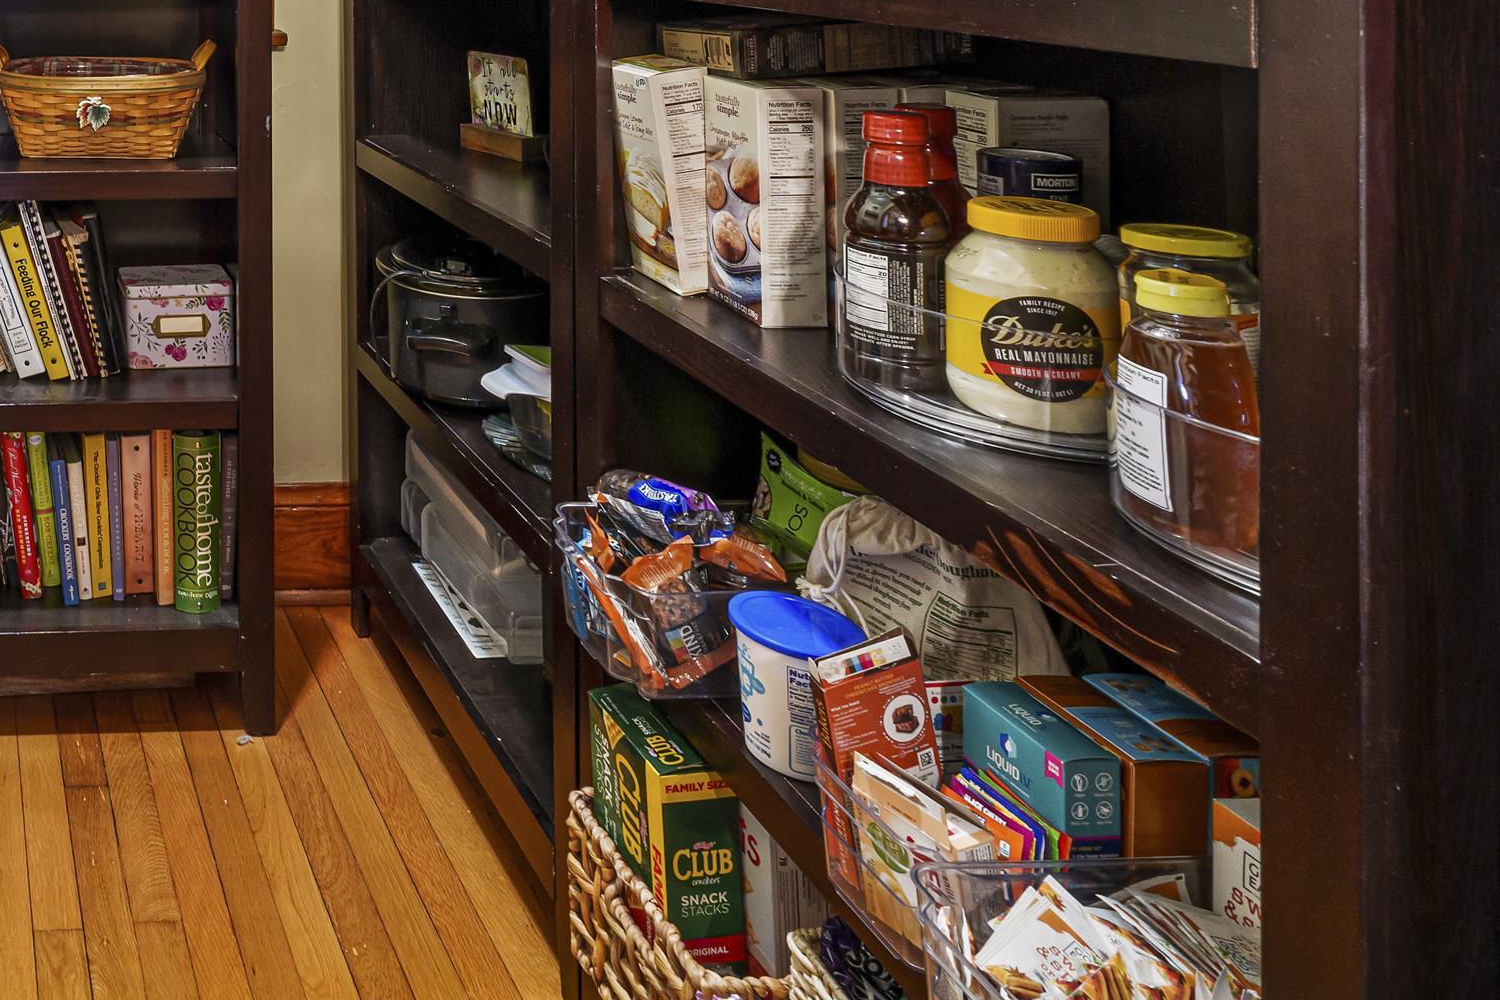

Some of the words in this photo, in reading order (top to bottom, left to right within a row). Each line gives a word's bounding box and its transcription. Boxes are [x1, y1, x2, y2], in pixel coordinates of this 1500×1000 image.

[481, 57, 493, 77] It
[500, 60, 516, 78] all
[485, 79, 515, 101] starts
[715, 94, 741, 108] tastefully
[483, 99, 517, 125] NOW
[692, 103, 703, 111] 170
[768, 101, 795, 109] Nutrition
[801, 124, 813, 132] 260
[1036, 178, 1076, 188] MORTON
[14, 257, 37, 298] Feeding
[27, 298, 44, 320] Our
[1019, 299, 1042, 309] FAMILY
[1043, 301, 1066, 312] RECIPE
[1027, 307, 1045, 315] SINCE
[35, 319, 54, 348] Flock
[983, 315, 1095, 349] Duke's
[995, 348, 1021, 361] REAL
[1023, 350, 1094, 365] MAYONNAISE
[1010, 367, 1042, 378] SMOOTH
[1051, 371, 1081, 379] CREAMY
[1137, 371, 1160, 385] Facts
[132, 472, 142, 501] Works
[59, 507, 69, 541] CROCKERY
[176, 452, 196, 584] COOKBOOK
[16, 524, 26, 564] DRUMMOND
[21, 515, 32, 556] DINNERTIME
[133, 513, 144, 562] HEART
[162, 522, 170, 574] COOKBOOK
[62, 543, 73, 580] COOKBOOK
[96, 536, 104, 569] Companion
[789, 679, 812, 688] Fact
[1008, 703, 1043, 727] LIQUID
[646, 733, 684, 766] CLUB
[601, 736, 613, 807] SNACK
[986, 744, 1020, 781] LIQUID
[665, 780, 704, 795] FAMILY
[615, 753, 642, 865] CLUB
[962, 792, 985, 811] BLACK
[981, 806, 1007, 827] CHERRY
[672, 848, 734, 881] CLUB
[691, 876, 721, 886] crackers
[681, 891, 728, 907] SNACK
[681, 903, 730, 918] STACKS
